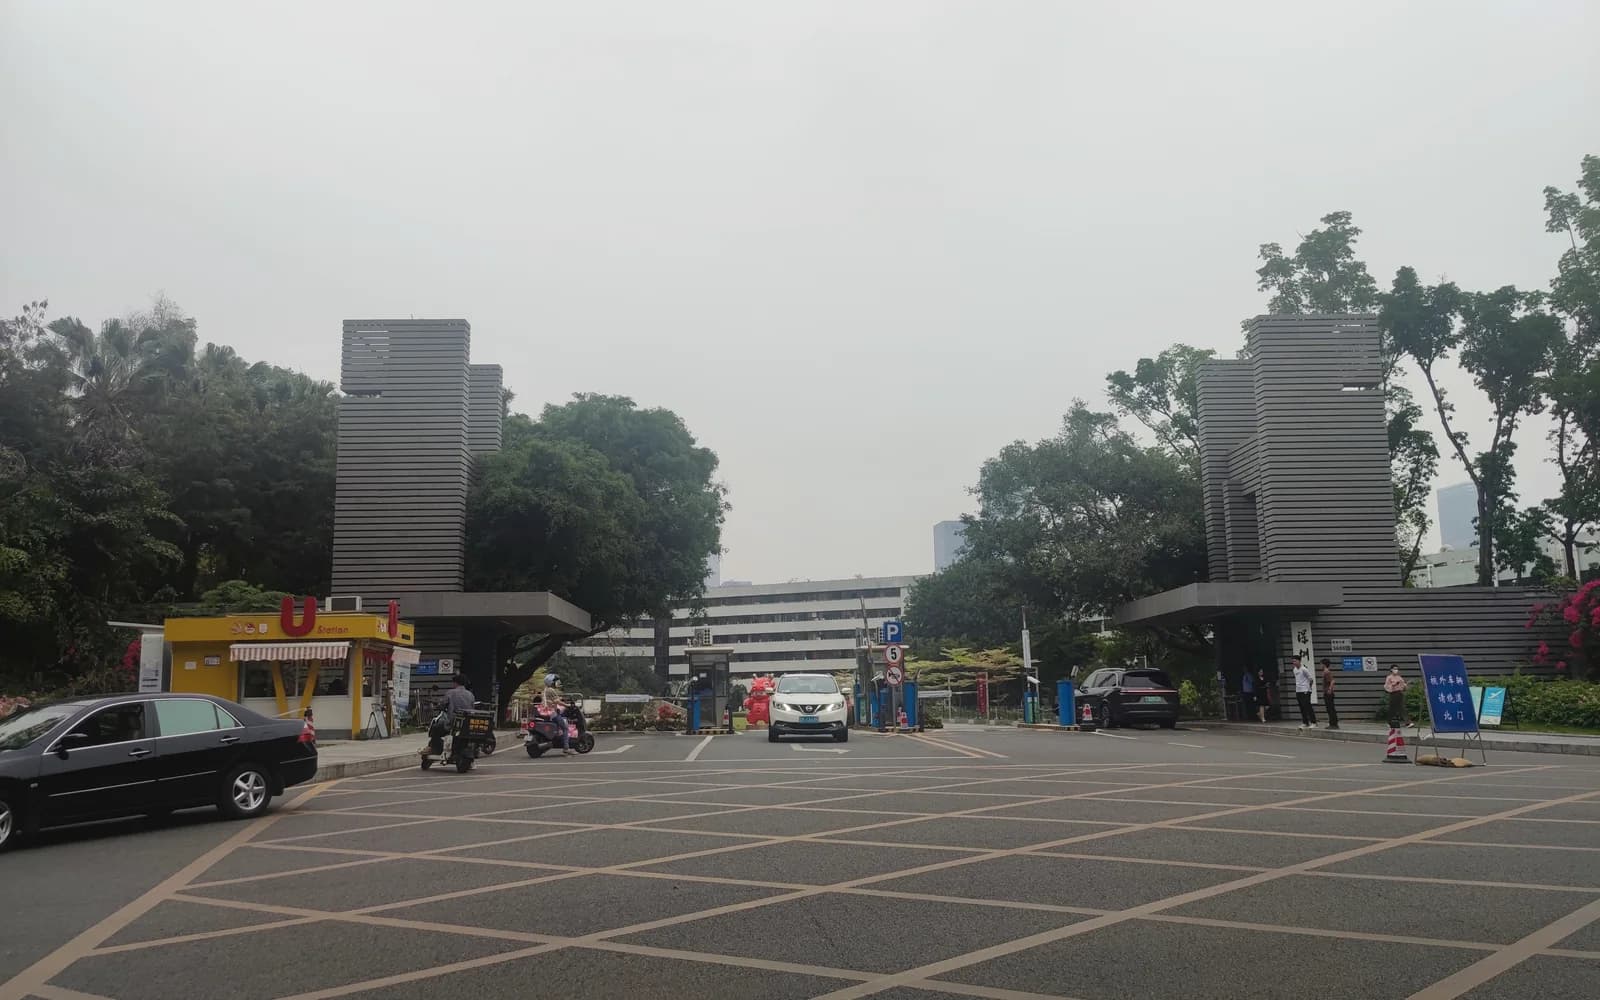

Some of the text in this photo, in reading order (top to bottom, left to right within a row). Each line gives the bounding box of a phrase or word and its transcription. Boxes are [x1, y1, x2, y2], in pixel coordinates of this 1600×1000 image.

[280, 595, 349, 637] U Station
[887, 624, 899, 641] P
[890, 647, 897, 660] 5
[1444, 710, 1464, 721] 北门
